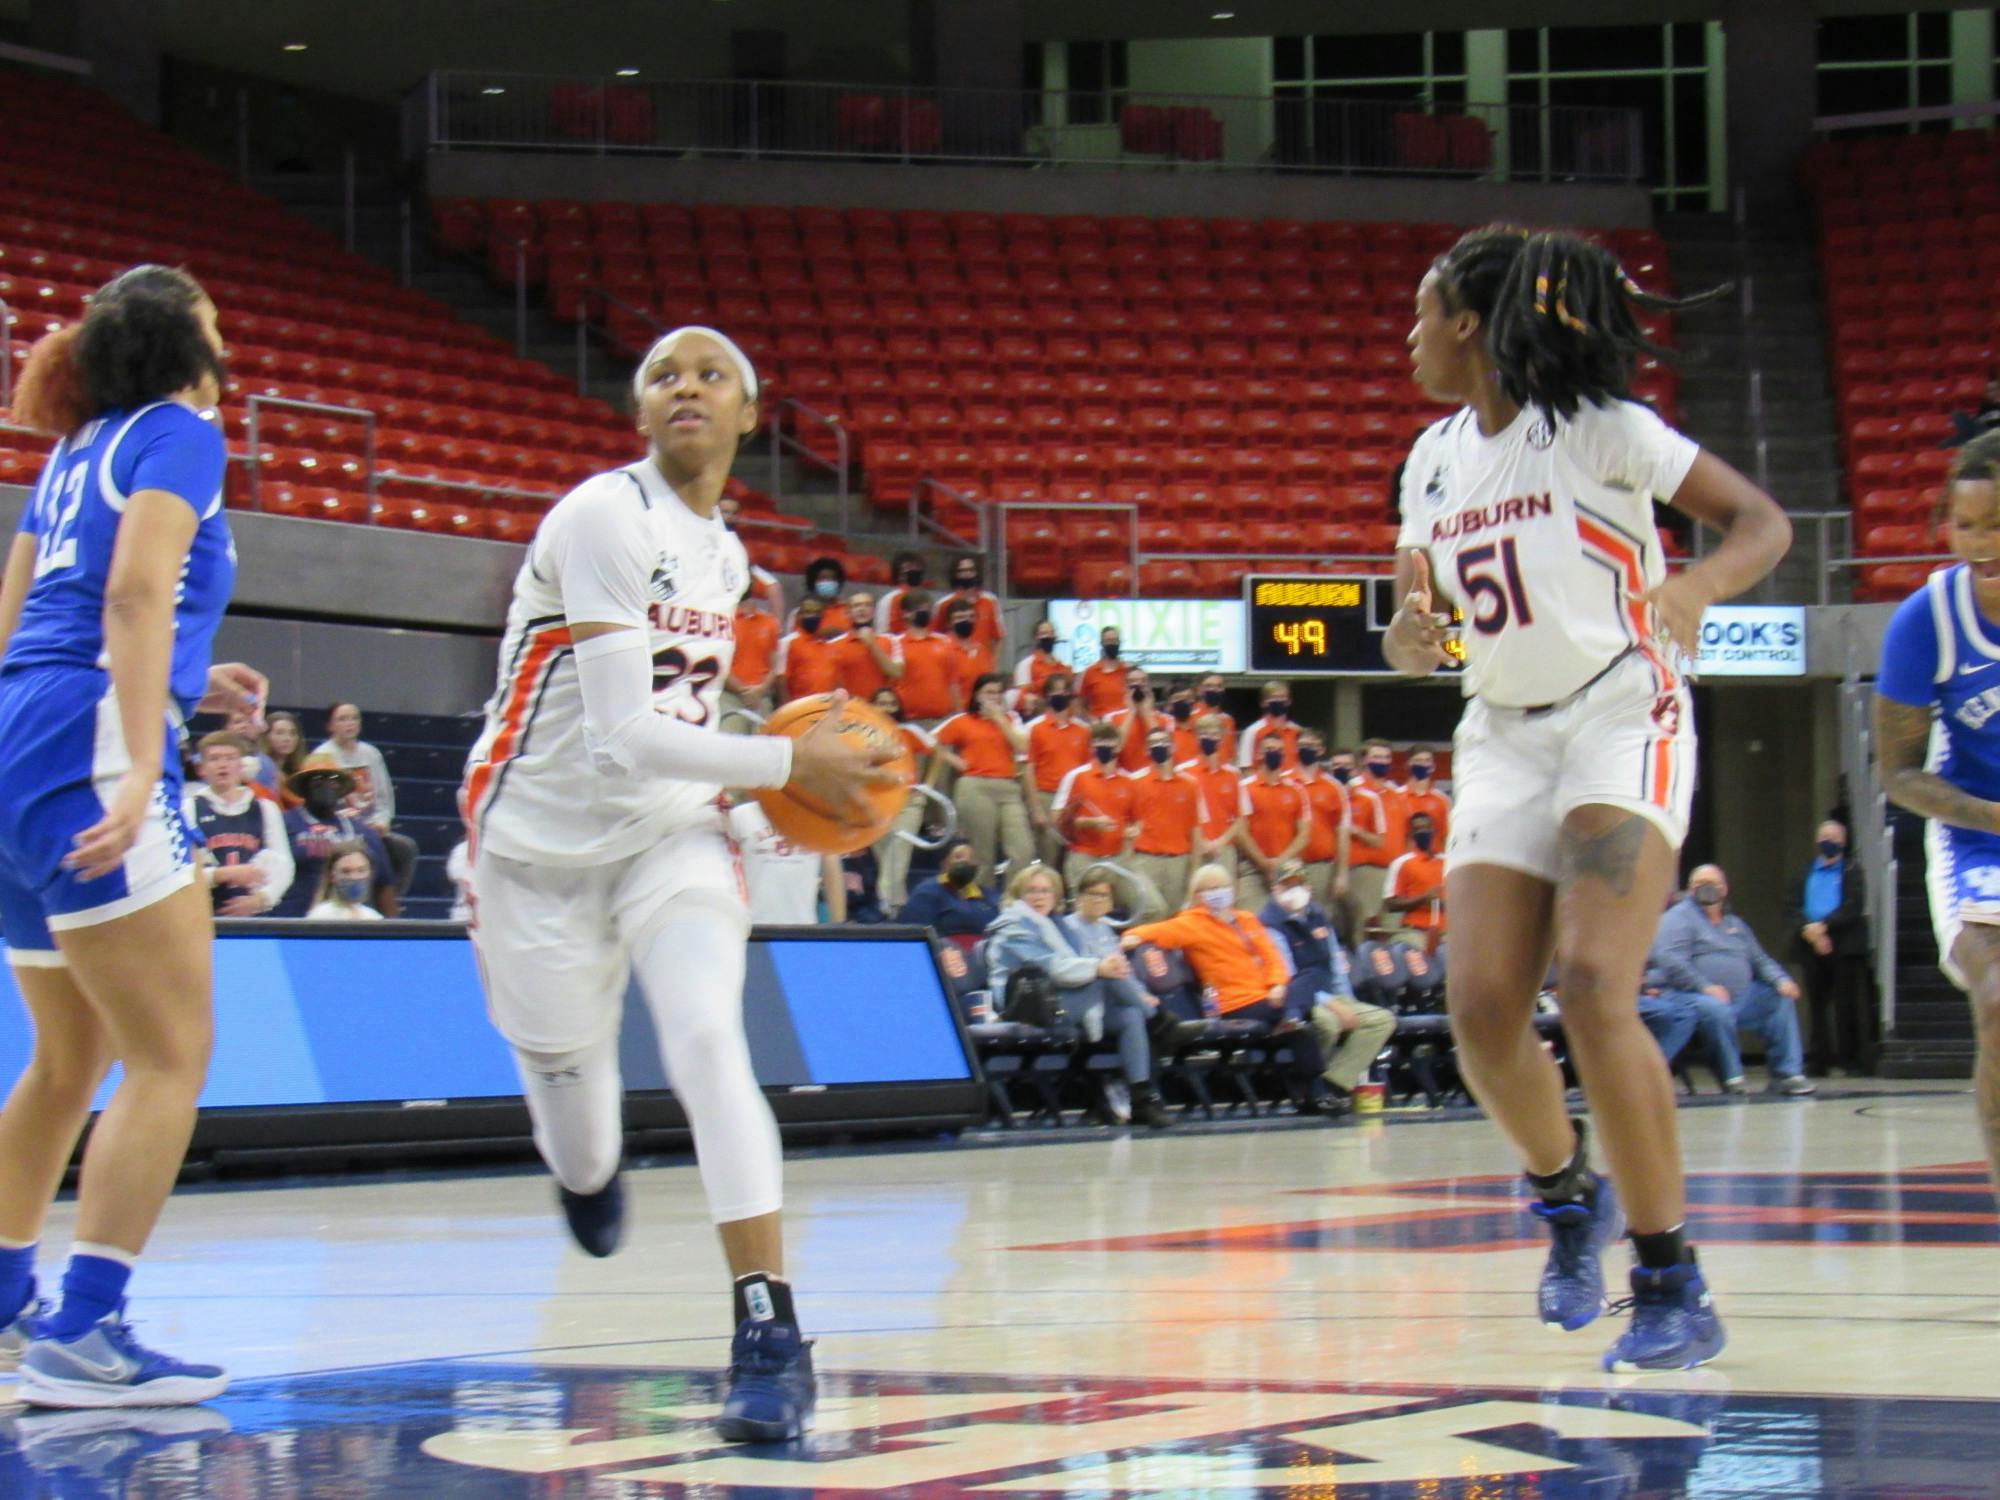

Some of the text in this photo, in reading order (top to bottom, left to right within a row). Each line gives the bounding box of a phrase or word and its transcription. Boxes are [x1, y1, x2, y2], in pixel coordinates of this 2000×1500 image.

[33, 459, 89, 579] 12
[1431, 493, 1552, 541] AUBURN
[1456, 535, 1534, 636] 51
[648, 603, 735, 640] AUBUR
[1099, 601, 1222, 645] DIXIE
[1274, 620, 1325, 655] 49
[1701, 621, 1800, 646] OOK'S
[1723, 649, 1799, 661] CONTROL
